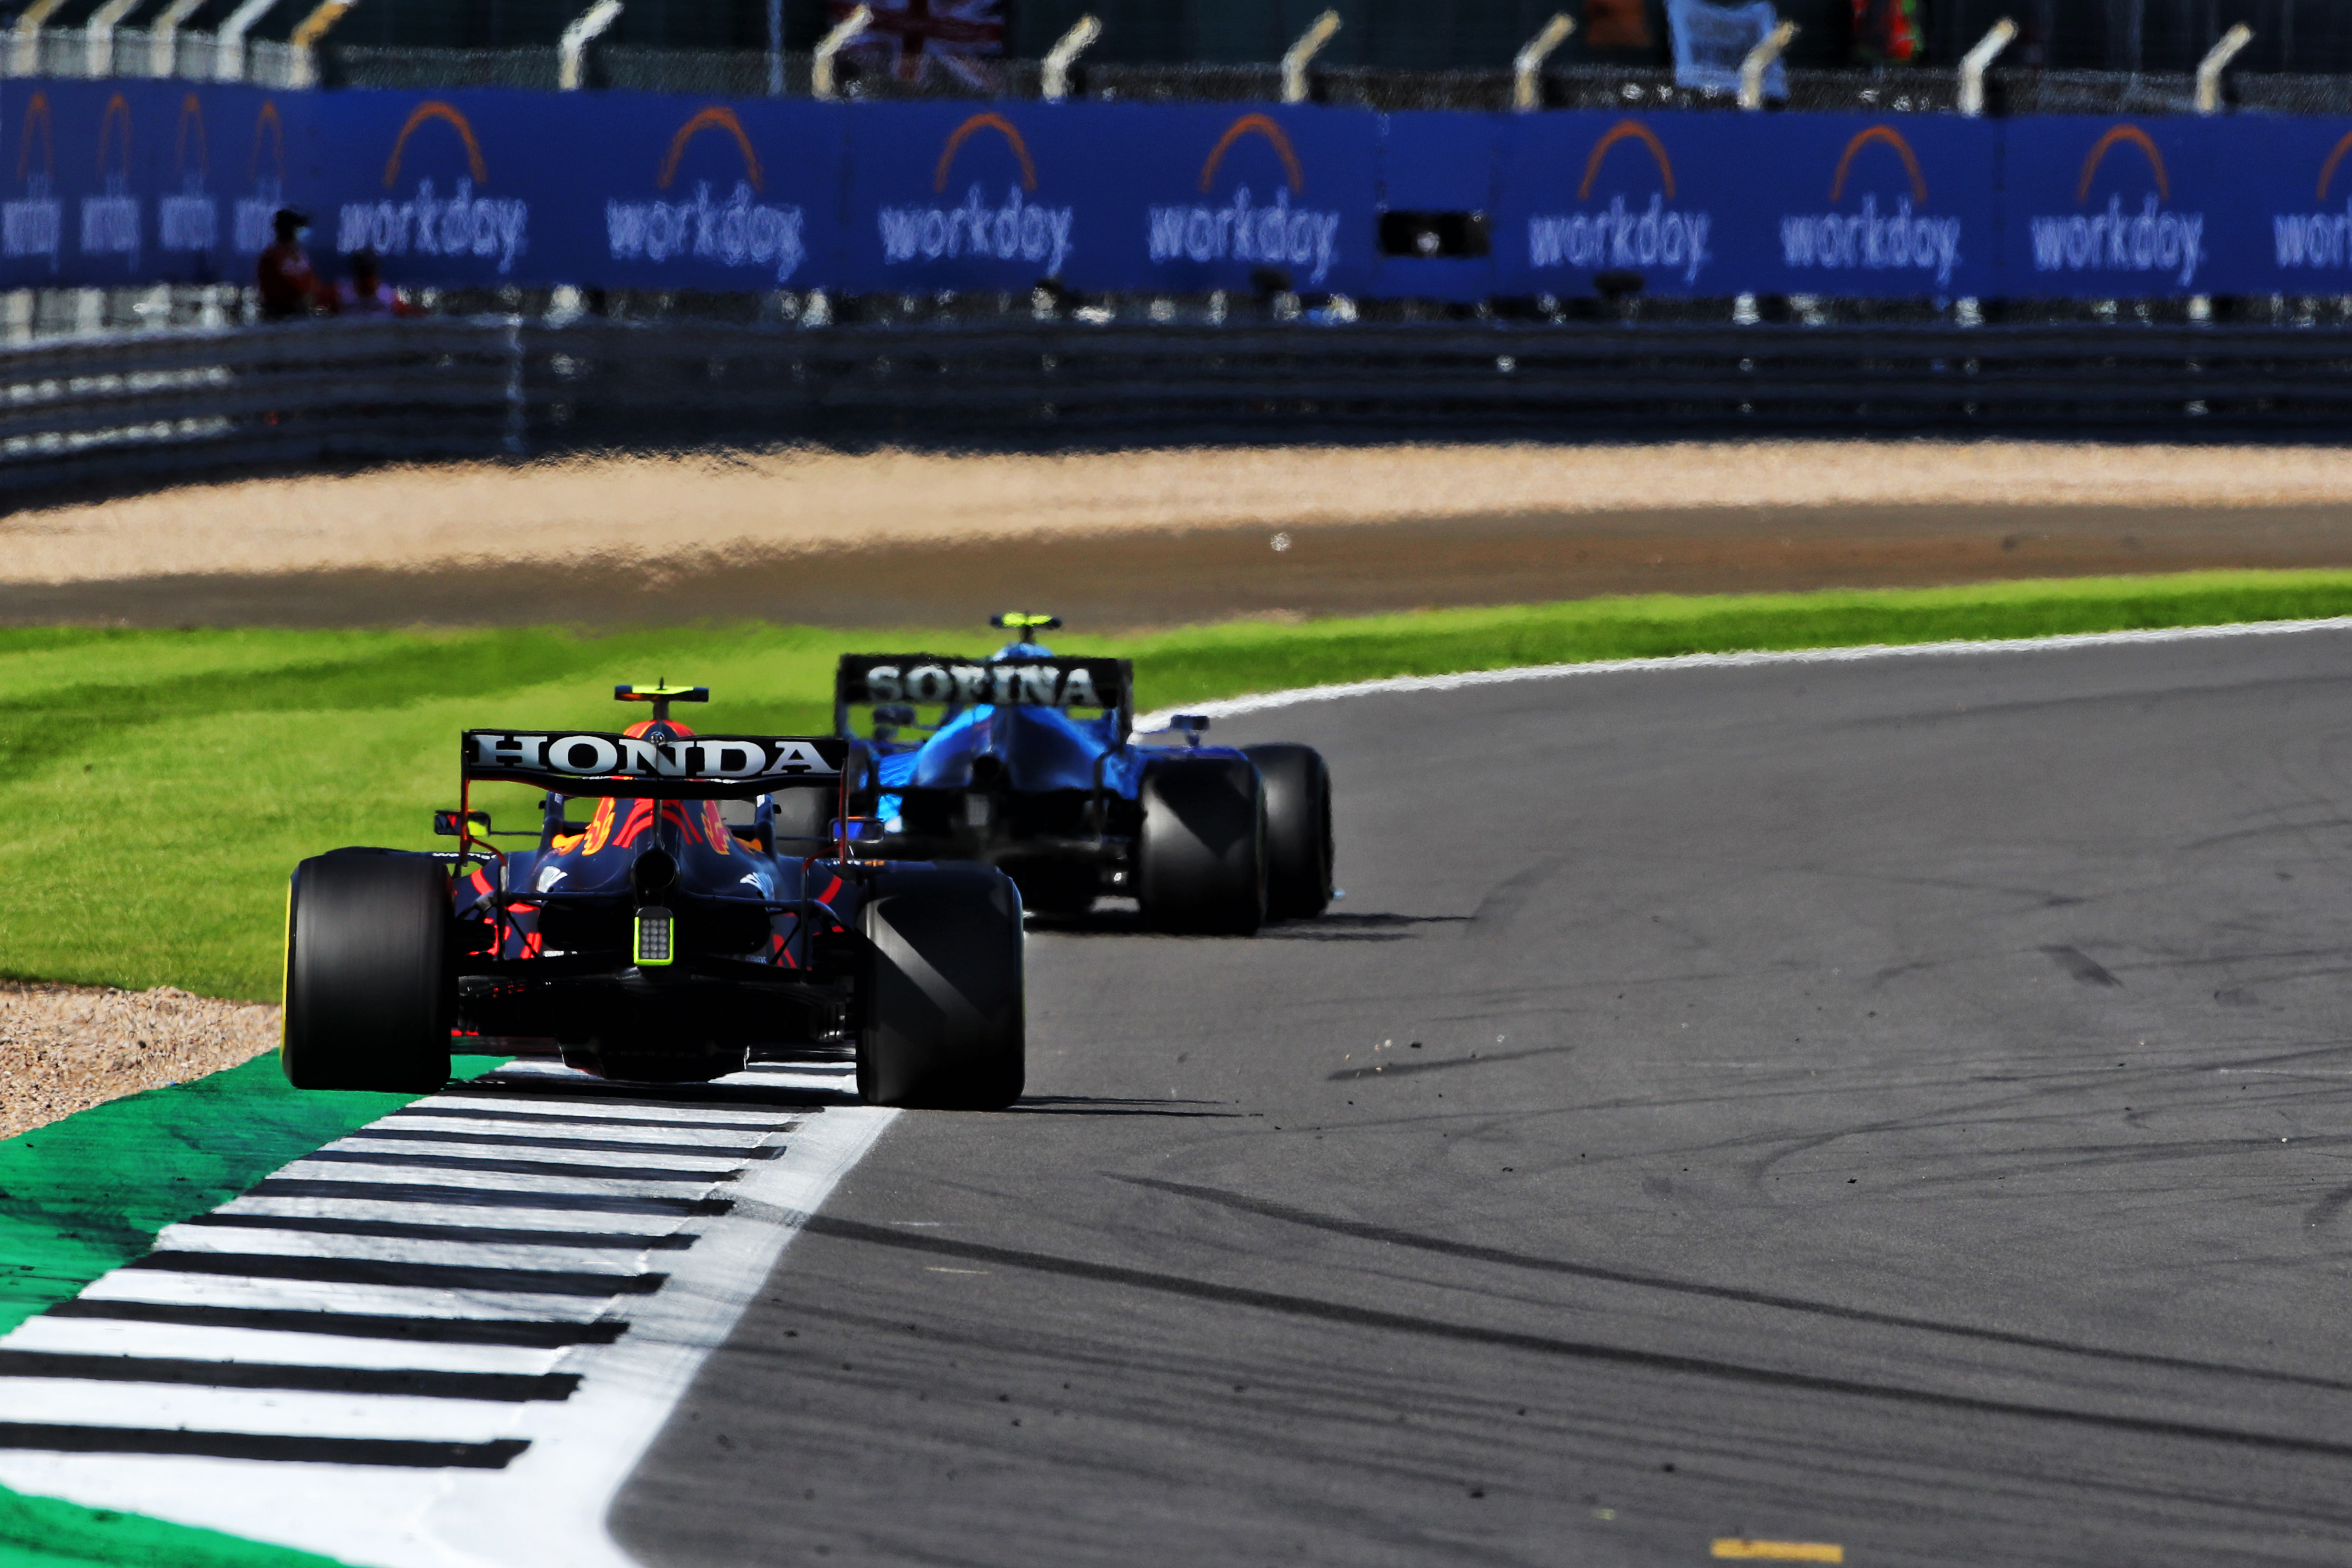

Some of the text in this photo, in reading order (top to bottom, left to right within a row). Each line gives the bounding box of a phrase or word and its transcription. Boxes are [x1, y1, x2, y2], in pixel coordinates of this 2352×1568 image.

[339, 177, 527, 272] workday
[607, 180, 805, 282] workday
[879, 182, 1072, 276] workday
[1148, 184, 1340, 282] workday
[1529, 193, 1710, 284] workday
[1781, 192, 1961, 285] workday
[2030, 192, 2205, 287] workday
[2273, 197, 2352, 268] wor
[866, 665, 1104, 705] SOFINA
[470, 734, 841, 777] HONDA
